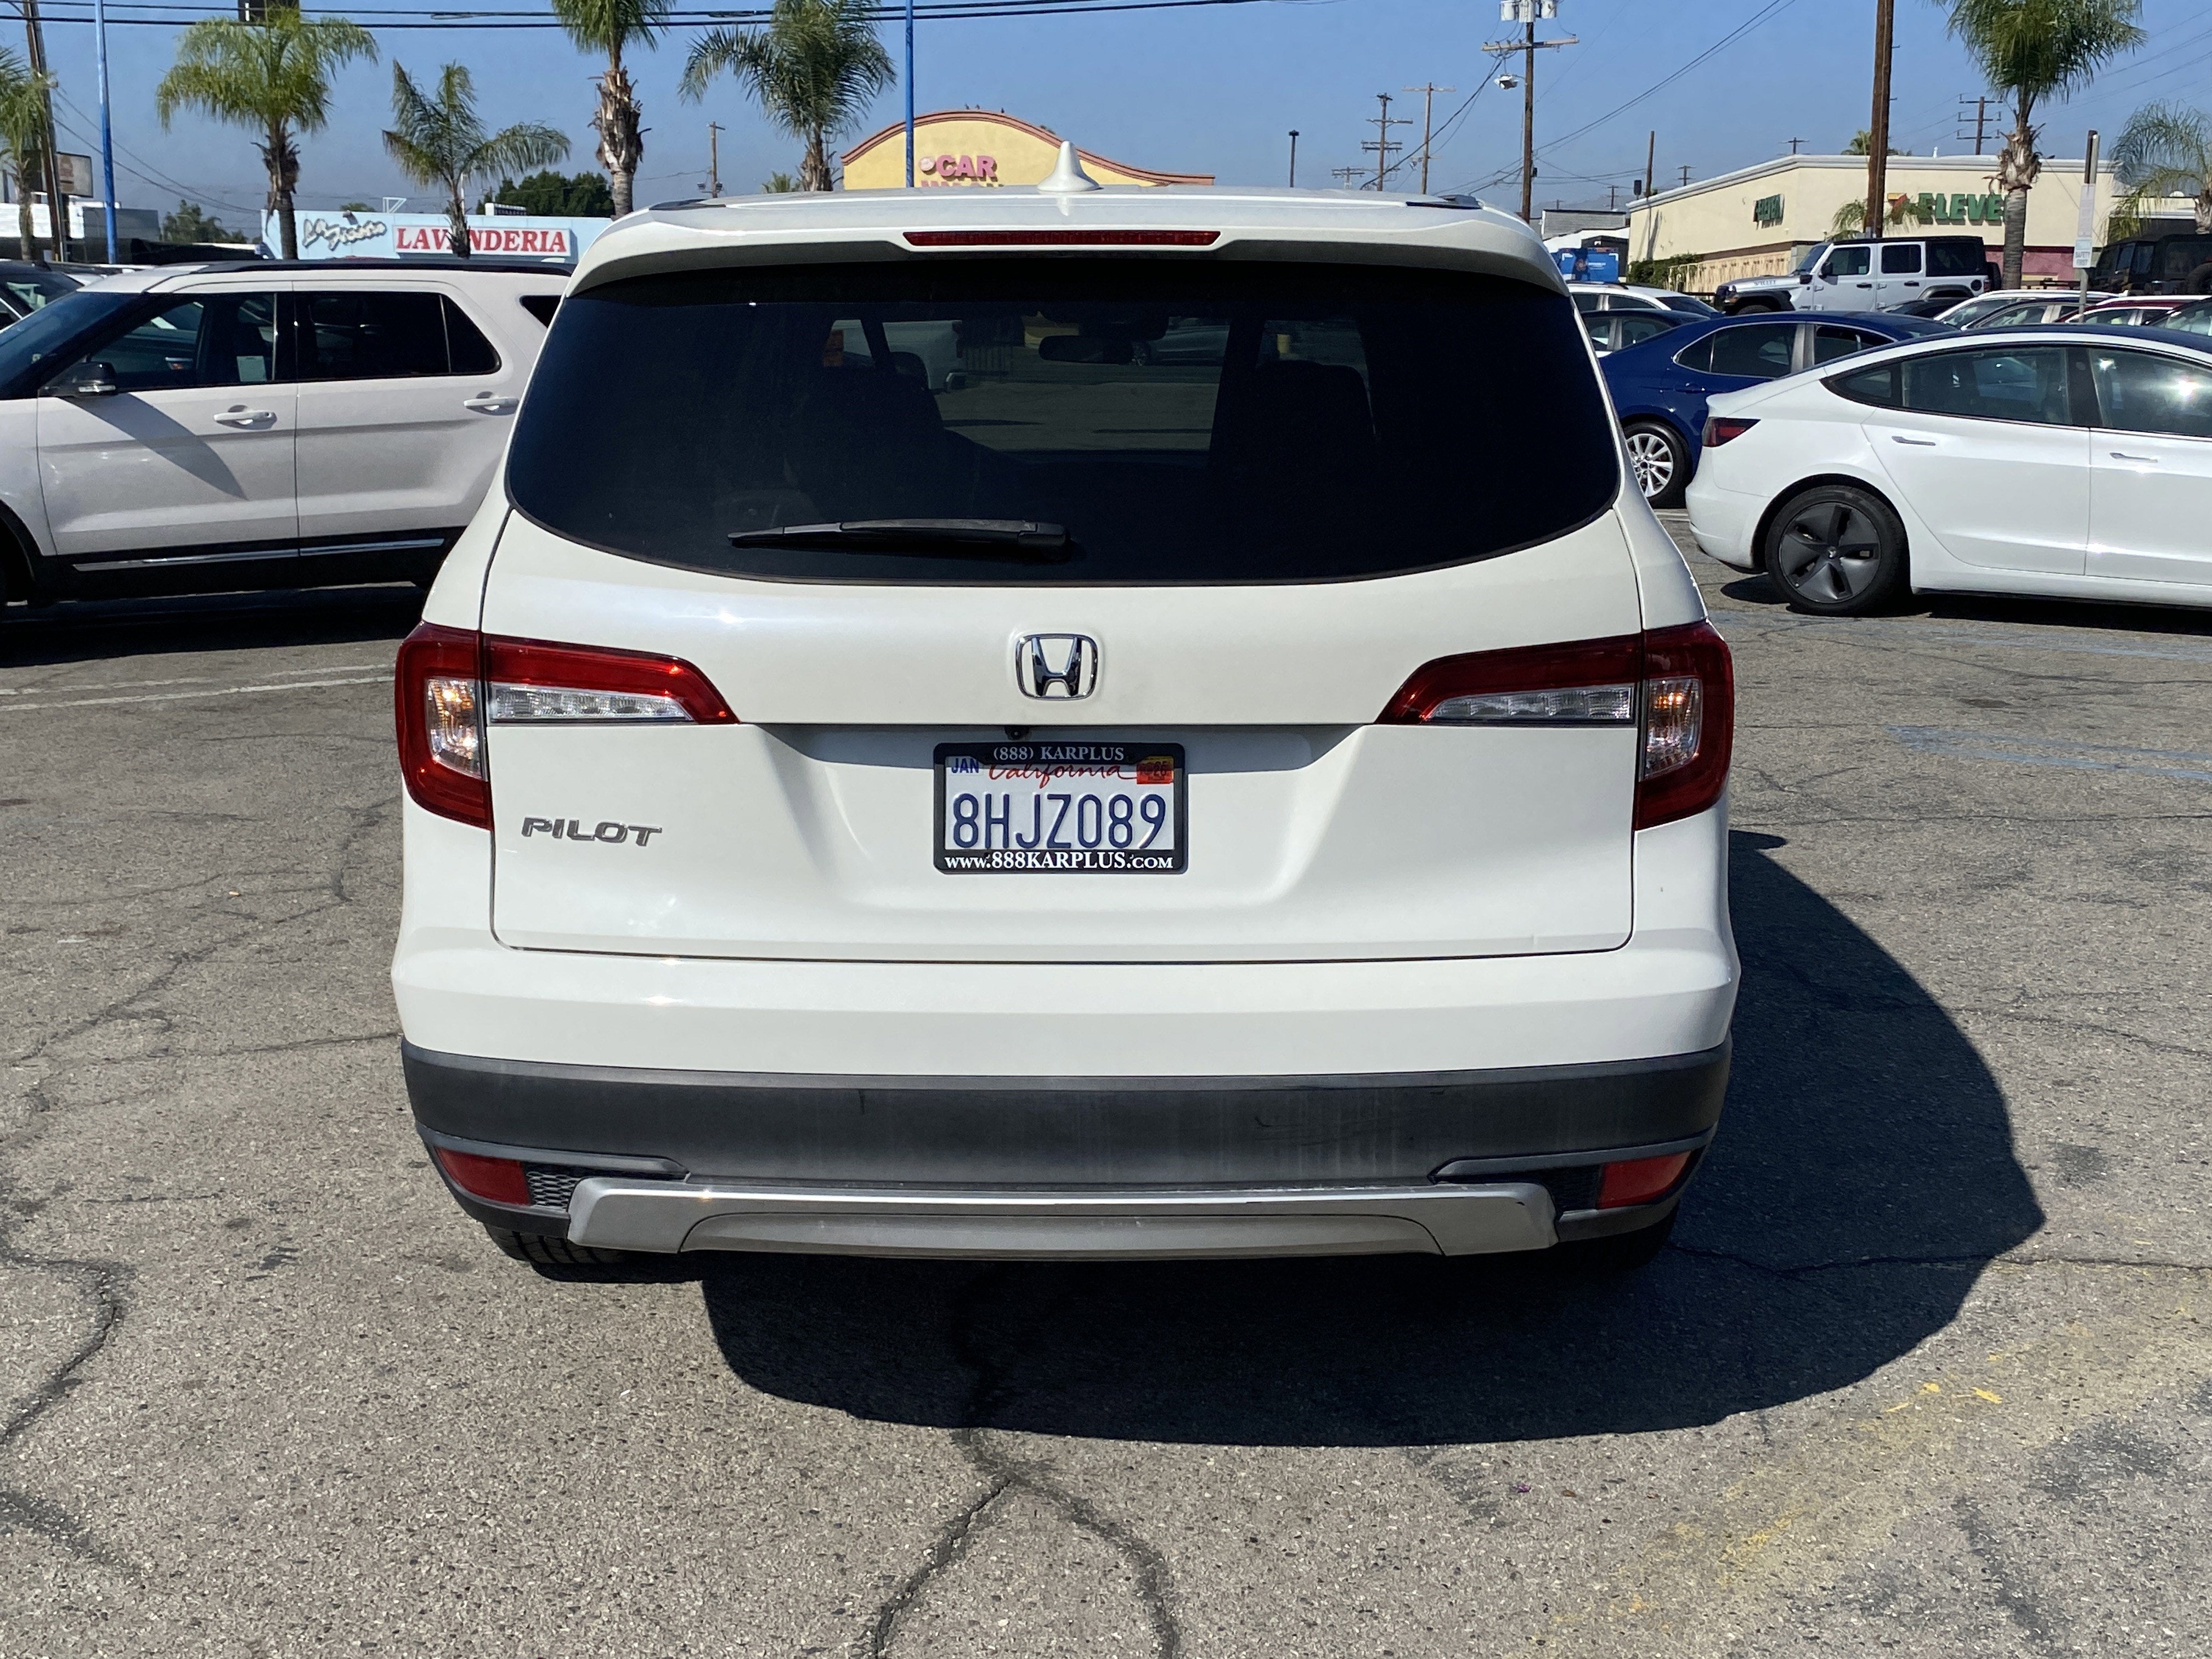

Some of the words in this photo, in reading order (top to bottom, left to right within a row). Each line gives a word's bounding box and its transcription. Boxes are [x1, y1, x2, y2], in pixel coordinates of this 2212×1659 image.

[936, 155, 997, 178] CAR
[396, 228, 567, 252] LAVNDERIA
[951, 758, 979, 774] JAN
[994, 747, 1034, 761] (888)
[1040, 747, 1124, 761] KARPLUS
[989, 763, 1130, 789] California
[521, 817, 663, 847] PILOT
[953, 793, 1166, 849] 8HJZ089
